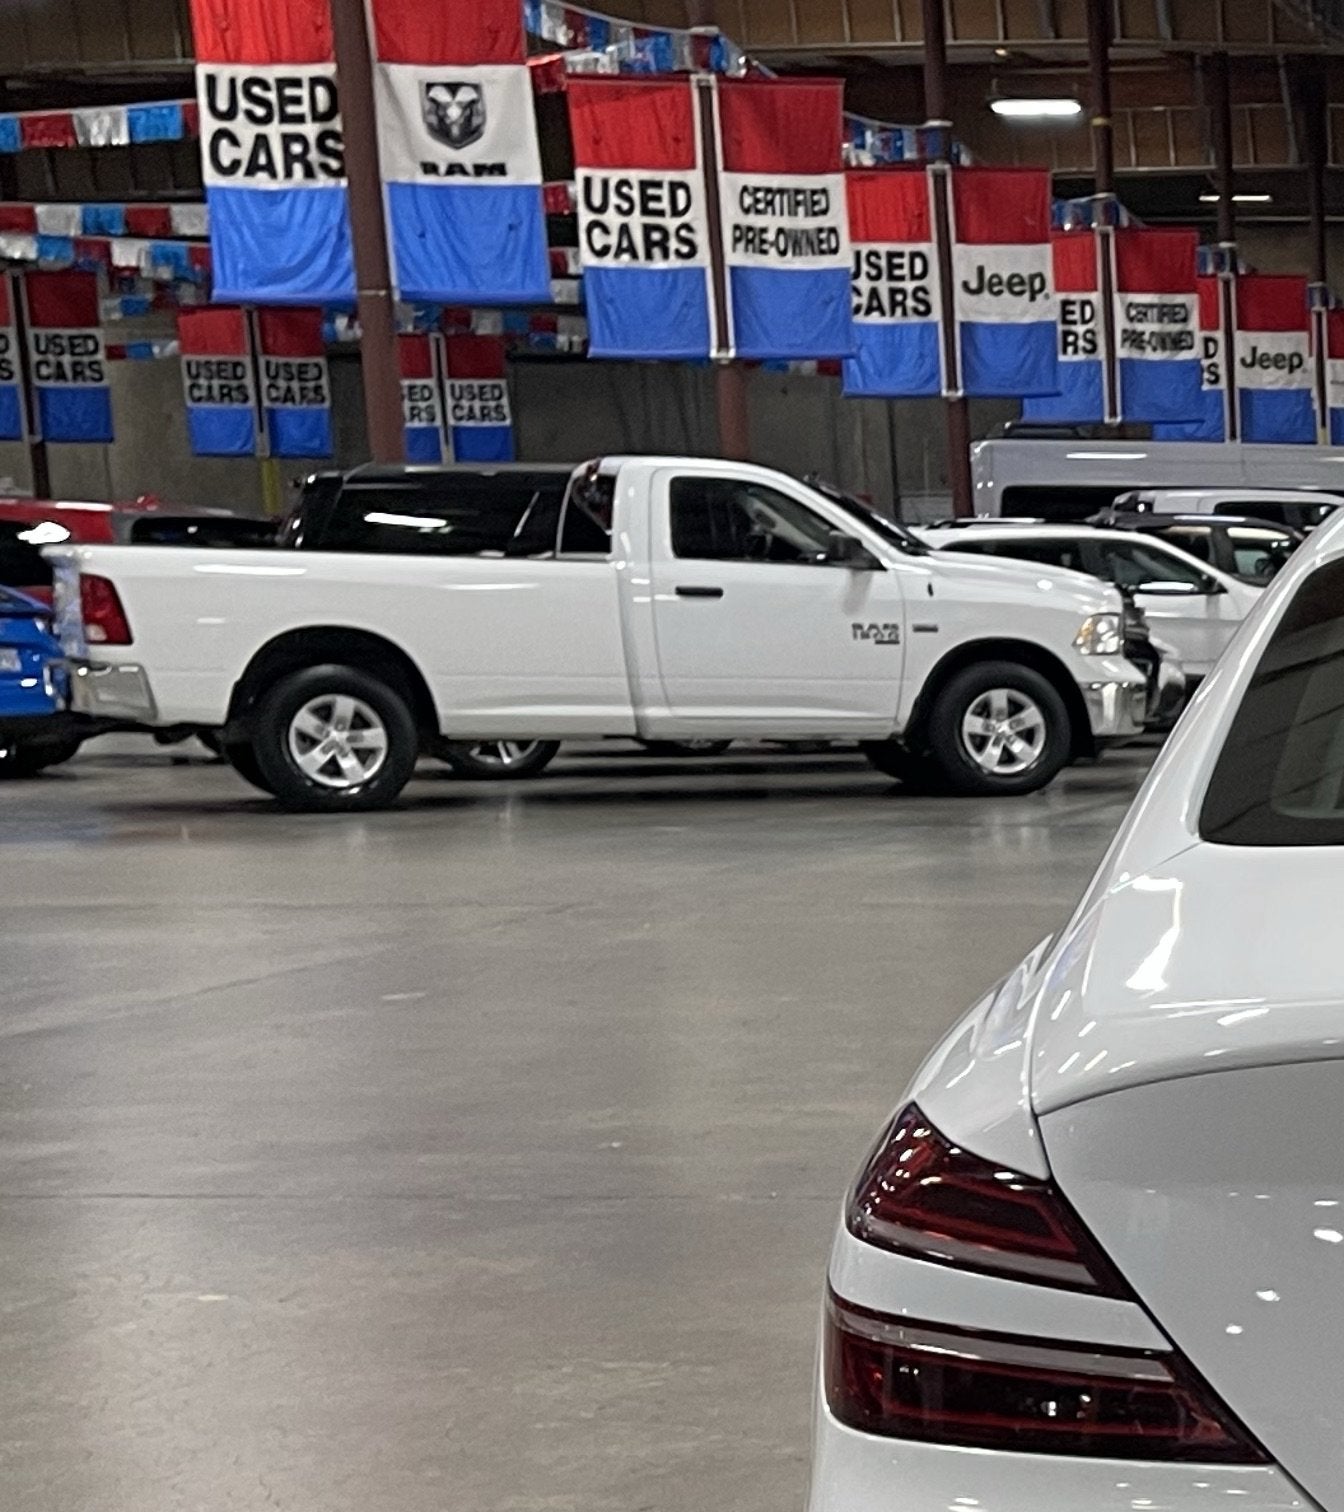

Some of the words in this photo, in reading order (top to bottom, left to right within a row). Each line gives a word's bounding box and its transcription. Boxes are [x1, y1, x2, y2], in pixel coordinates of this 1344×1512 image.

[205, 74, 338, 125] USED
[209, 128, 346, 179] CARS
[583, 176, 692, 218] USED
[739, 185, 830, 217] CERTIFIED
[586, 221, 698, 262] CARS
[732, 224, 839, 258] PRE-OWNED
[962, 265, 1046, 302] Jeep
[34, 333, 99, 356] USED
[36, 360, 104, 382] CARS
[186, 361, 246, 380] USED
[265, 361, 323, 382] USED
[1240, 345, 1304, 375] Jeep
[188, 383, 249, 403] CARS
[266, 384, 326, 404] CARS
[450, 384, 503, 402] USED
[452, 404, 506, 422] CARS
